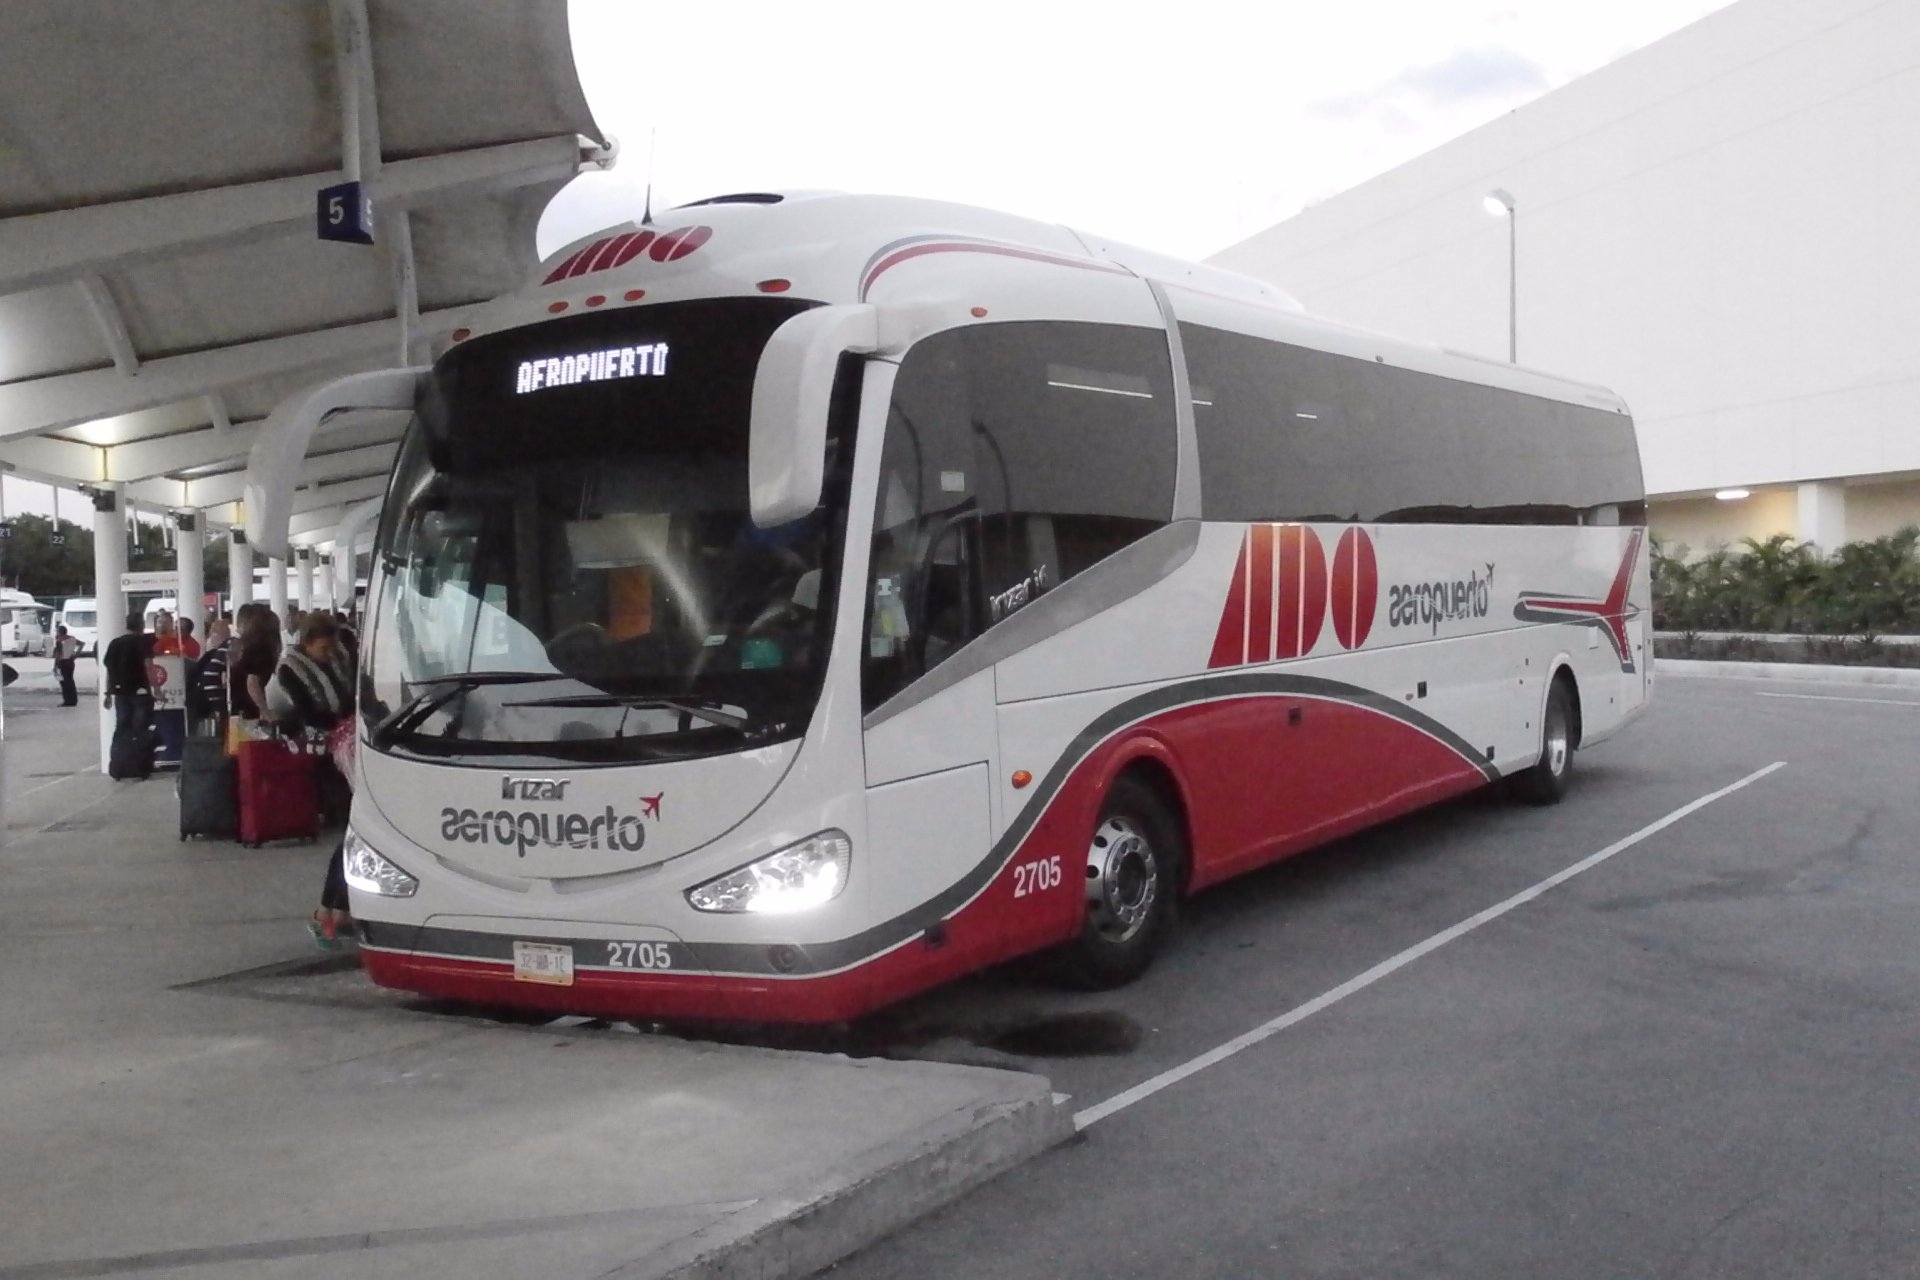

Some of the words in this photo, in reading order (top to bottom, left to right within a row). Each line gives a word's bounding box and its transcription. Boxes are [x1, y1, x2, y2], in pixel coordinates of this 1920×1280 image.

[329, 196, 344, 225] 5
[52, 535, 65, 544] 22
[1389, 569, 1488, 636] aeropuerto
[441, 805, 645, 858] aeropuerto
[1014, 855, 1061, 898] 2705
[607, 942, 671, 969] 2705
